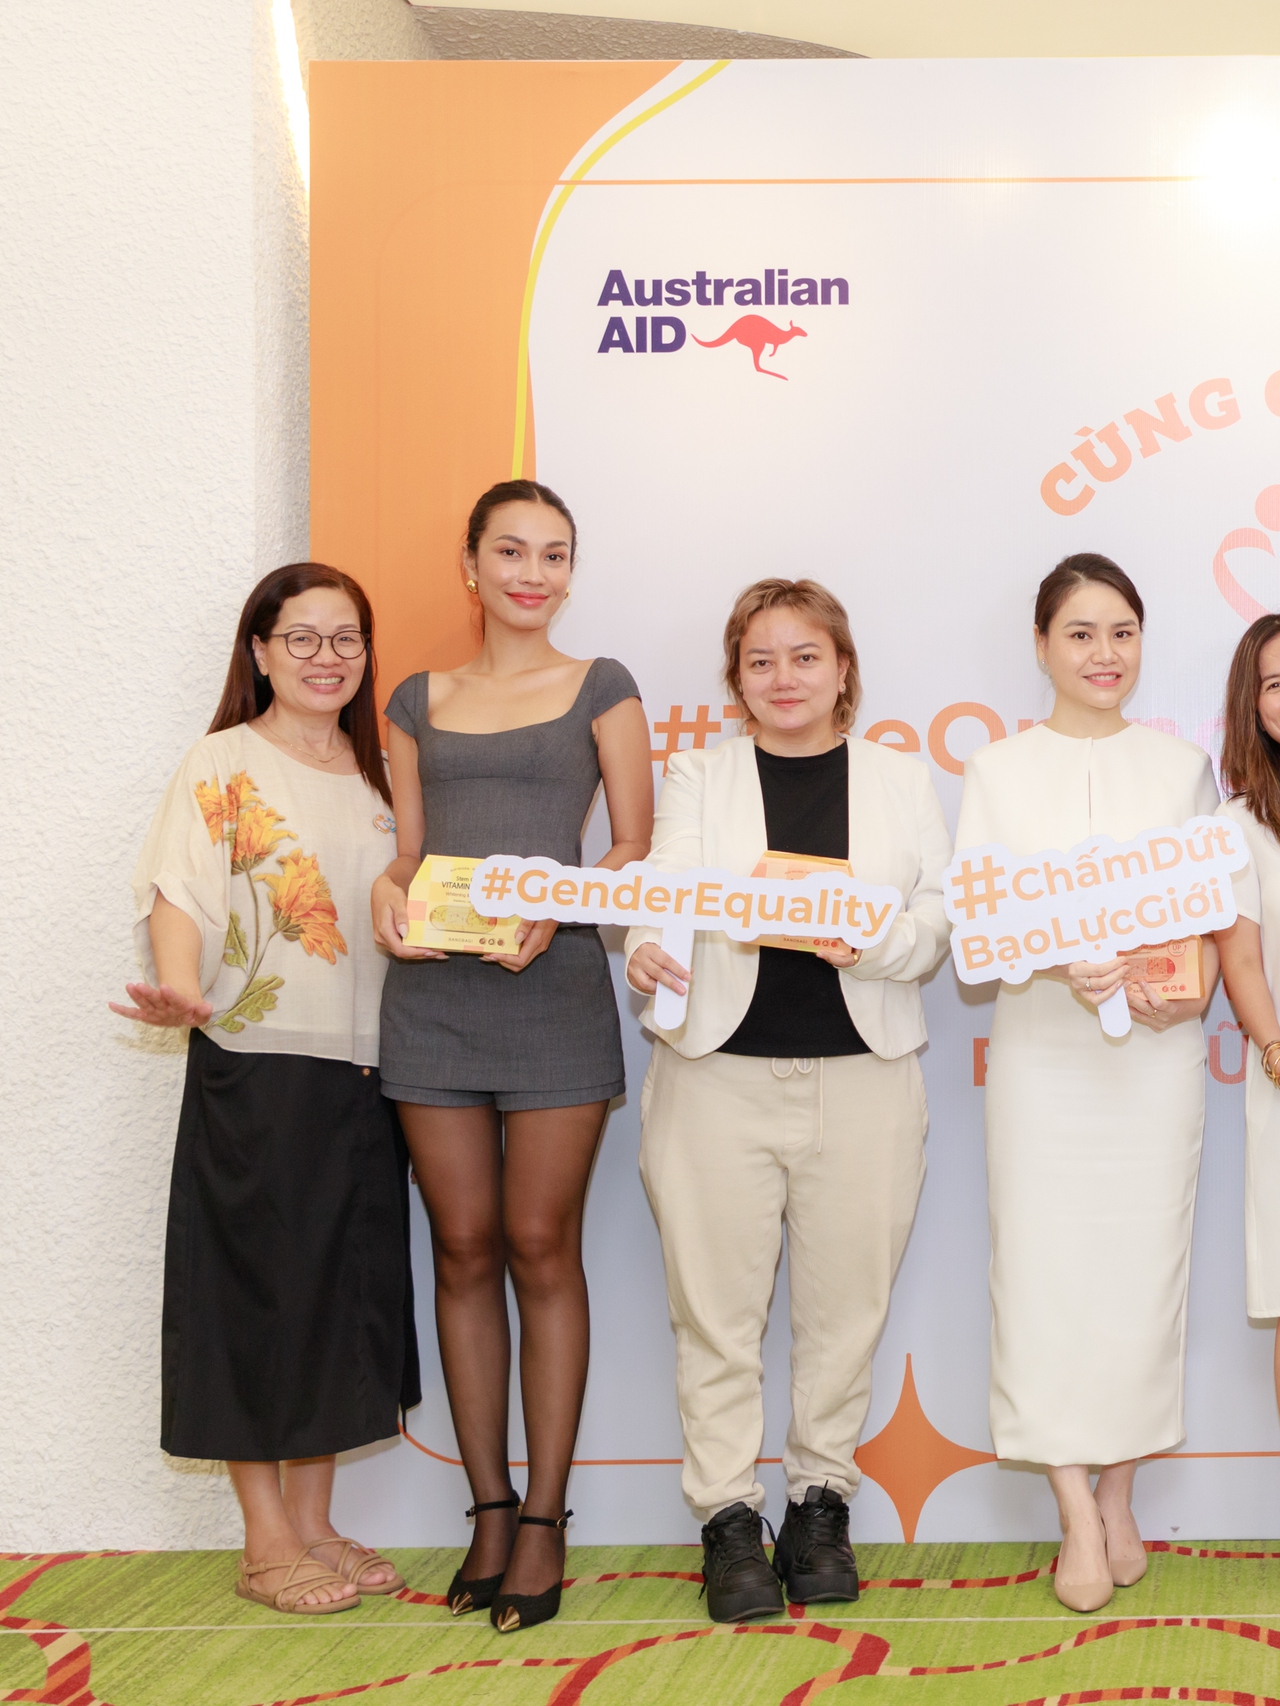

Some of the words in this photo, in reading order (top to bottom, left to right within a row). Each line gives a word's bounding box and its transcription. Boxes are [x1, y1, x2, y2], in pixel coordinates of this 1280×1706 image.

[596, 268, 850, 307] Australian
[596, 316, 687, 354] AID
[1039, 377, 1242, 517] CÙNG
[442, 881, 470, 890] VITAMIN
[481, 866, 893, 938] #GenderEquality
[950, 825, 1236, 921] #ChấmDứt
[960, 877, 1225, 971] BạoLựcGiới
